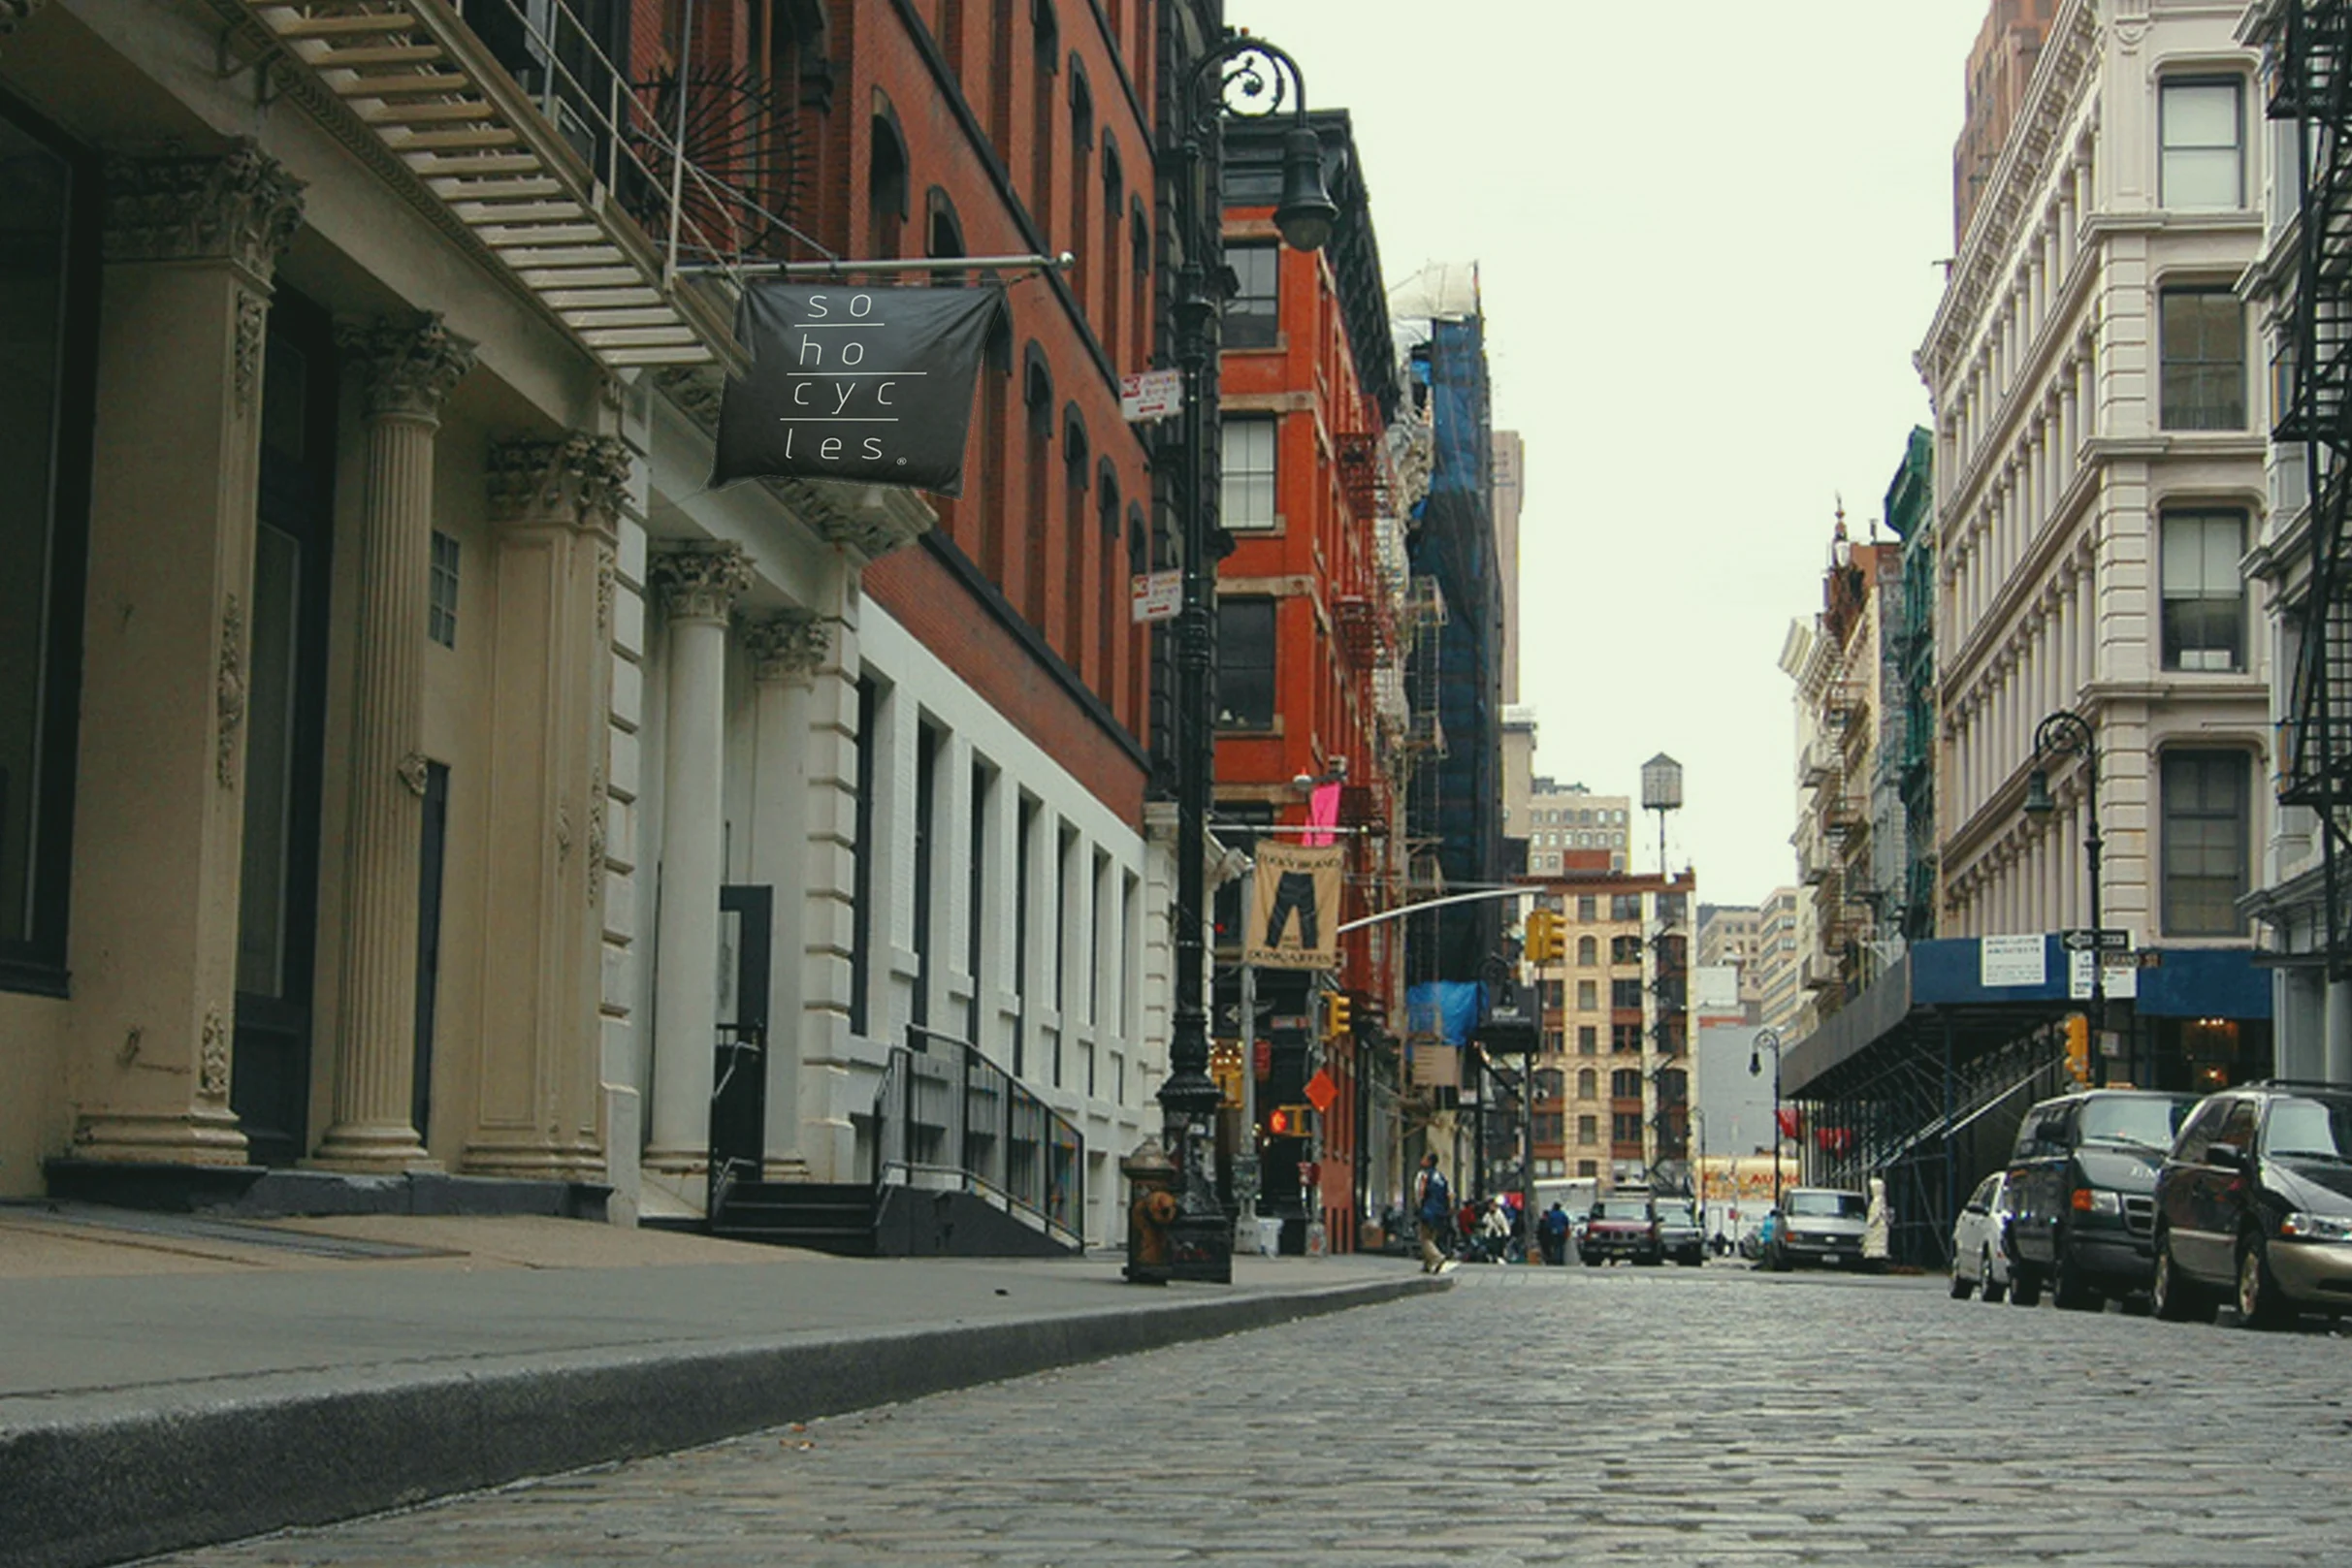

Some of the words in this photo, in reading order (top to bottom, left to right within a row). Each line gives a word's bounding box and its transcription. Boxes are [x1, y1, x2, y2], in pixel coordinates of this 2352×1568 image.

[807, 294, 872, 318] so
[799, 334, 864, 366] ho
[793, 381, 895, 415] cyc
